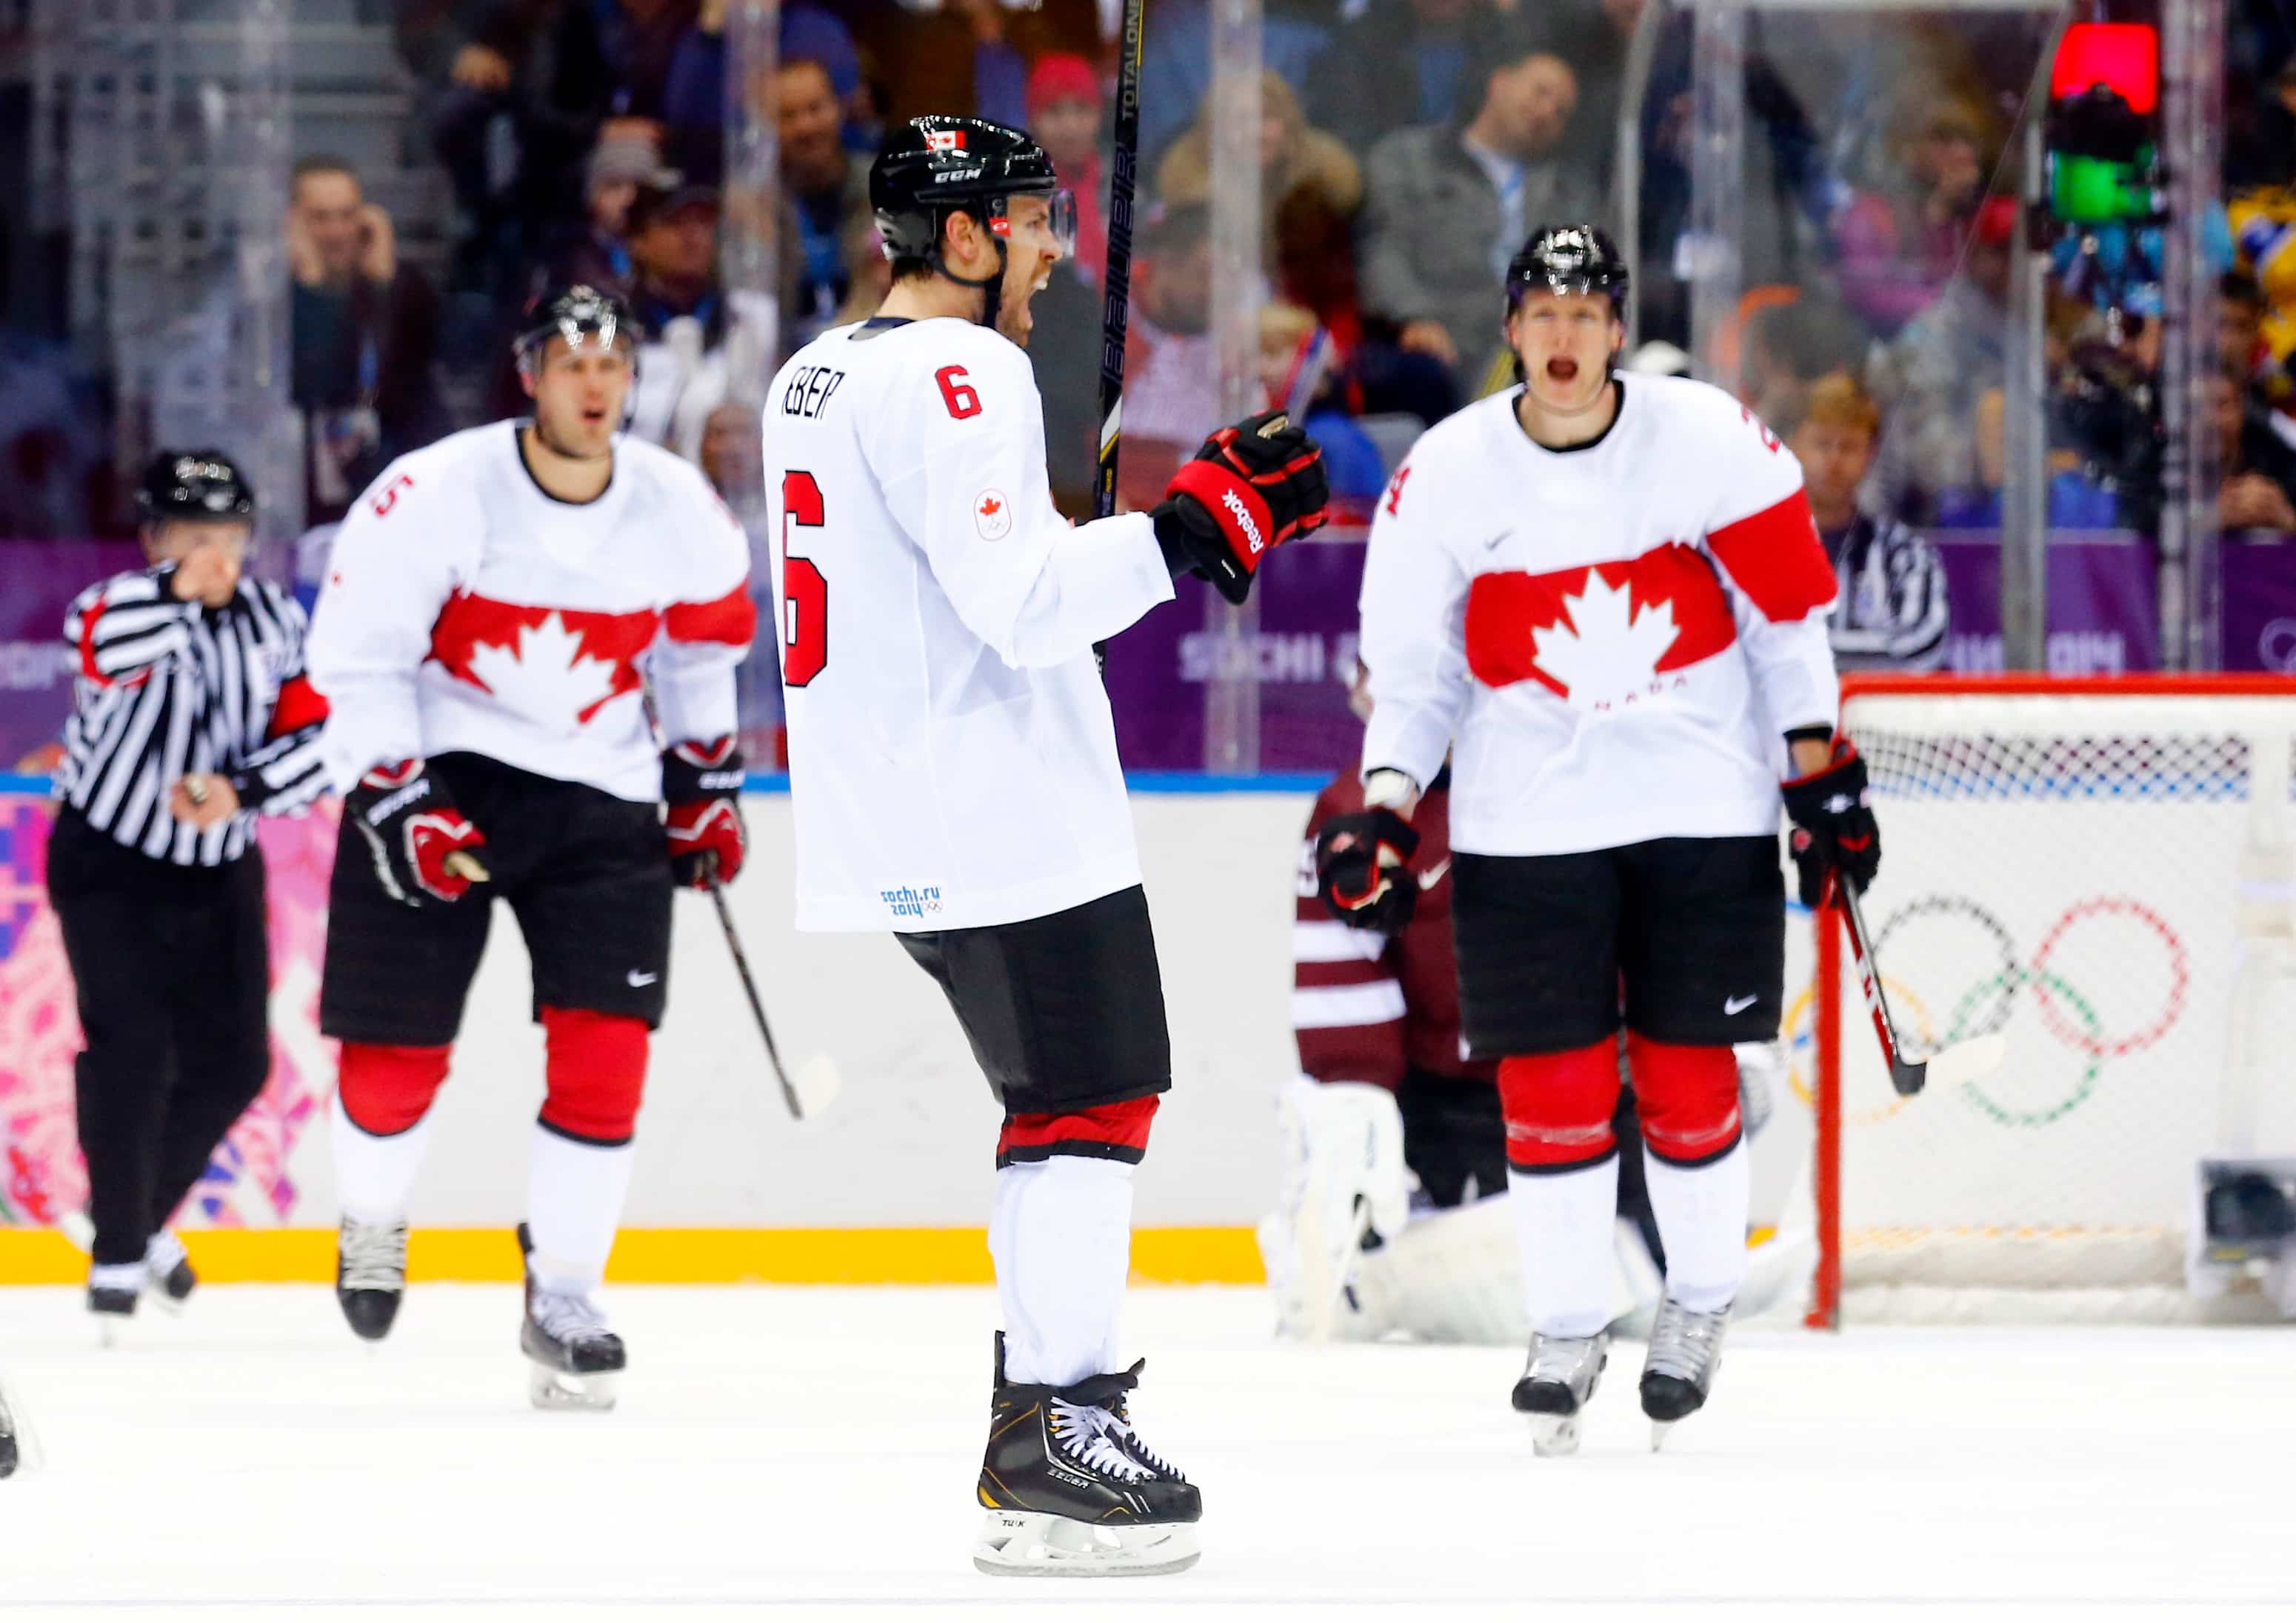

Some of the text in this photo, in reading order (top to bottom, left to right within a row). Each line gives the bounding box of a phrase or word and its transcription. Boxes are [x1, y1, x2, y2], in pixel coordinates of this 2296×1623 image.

[935, 168, 981, 184] CCM
[781, 366, 846, 420] EBER
[935, 364, 983, 420] 6
[1221, 487, 1264, 554] Reebok
[782, 470, 827, 687] 6
[880, 885, 941, 903] sochi.ru
[891, 903, 924, 919] 2014
